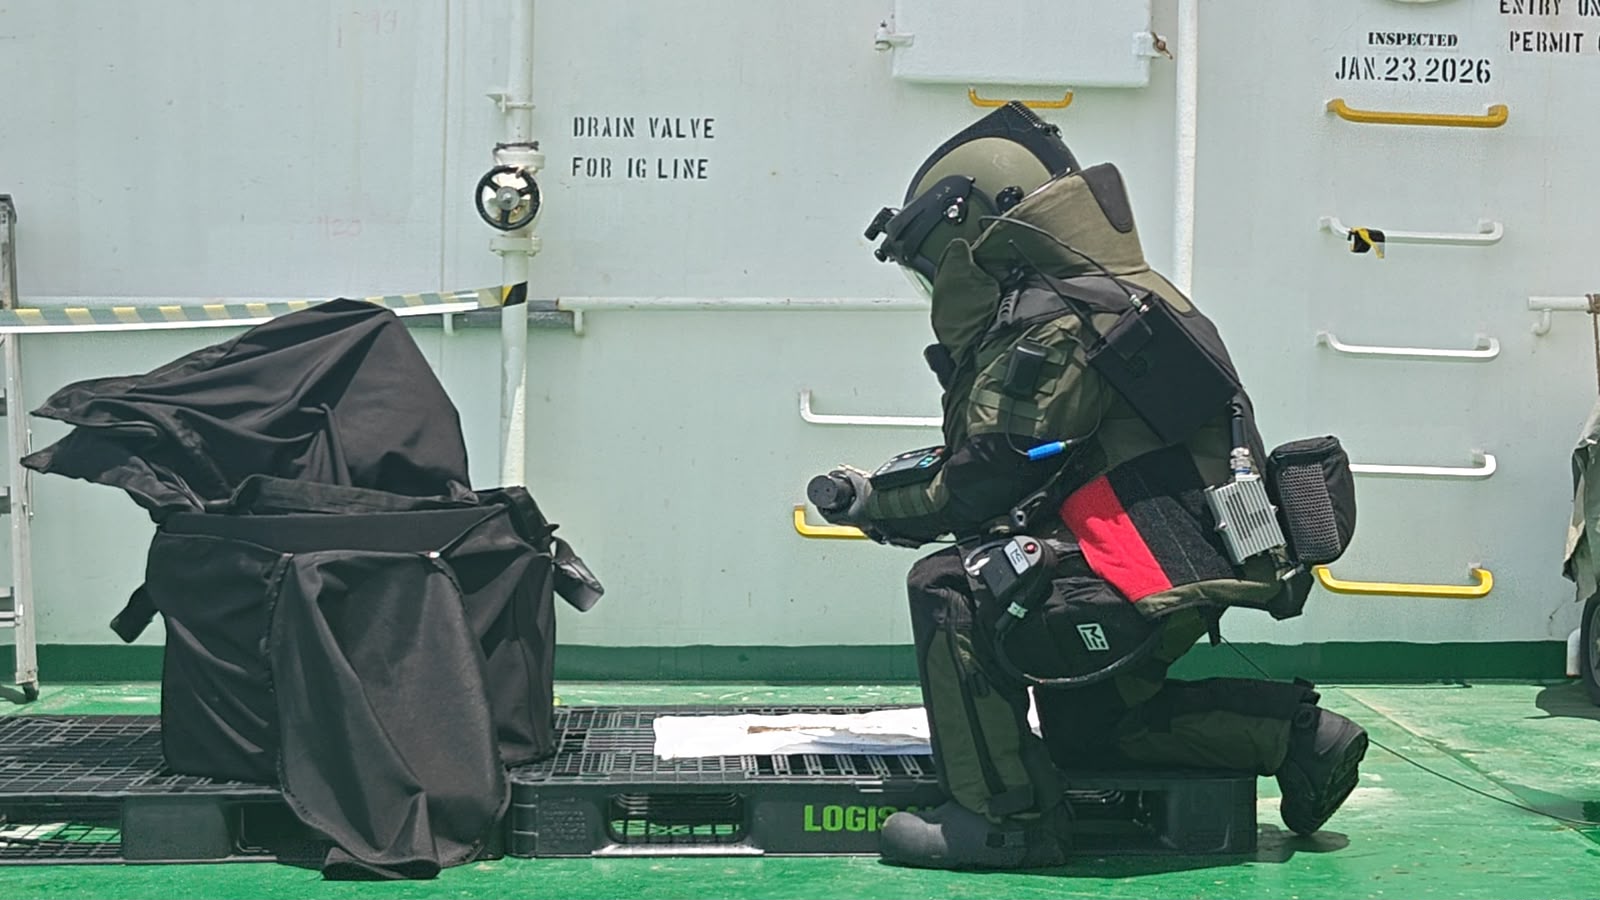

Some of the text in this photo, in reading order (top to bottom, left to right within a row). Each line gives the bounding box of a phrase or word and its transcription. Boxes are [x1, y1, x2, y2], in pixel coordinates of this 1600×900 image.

[1369, 32, 1457, 46] INSPECTED
[1510, 31, 1583, 53] PERMIT
[1336, 57, 1490, 83] JAN.23.2026
[574, 117, 714, 138] DRAIN VALVE
[573, 157, 708, 179] FOR IG LINE
